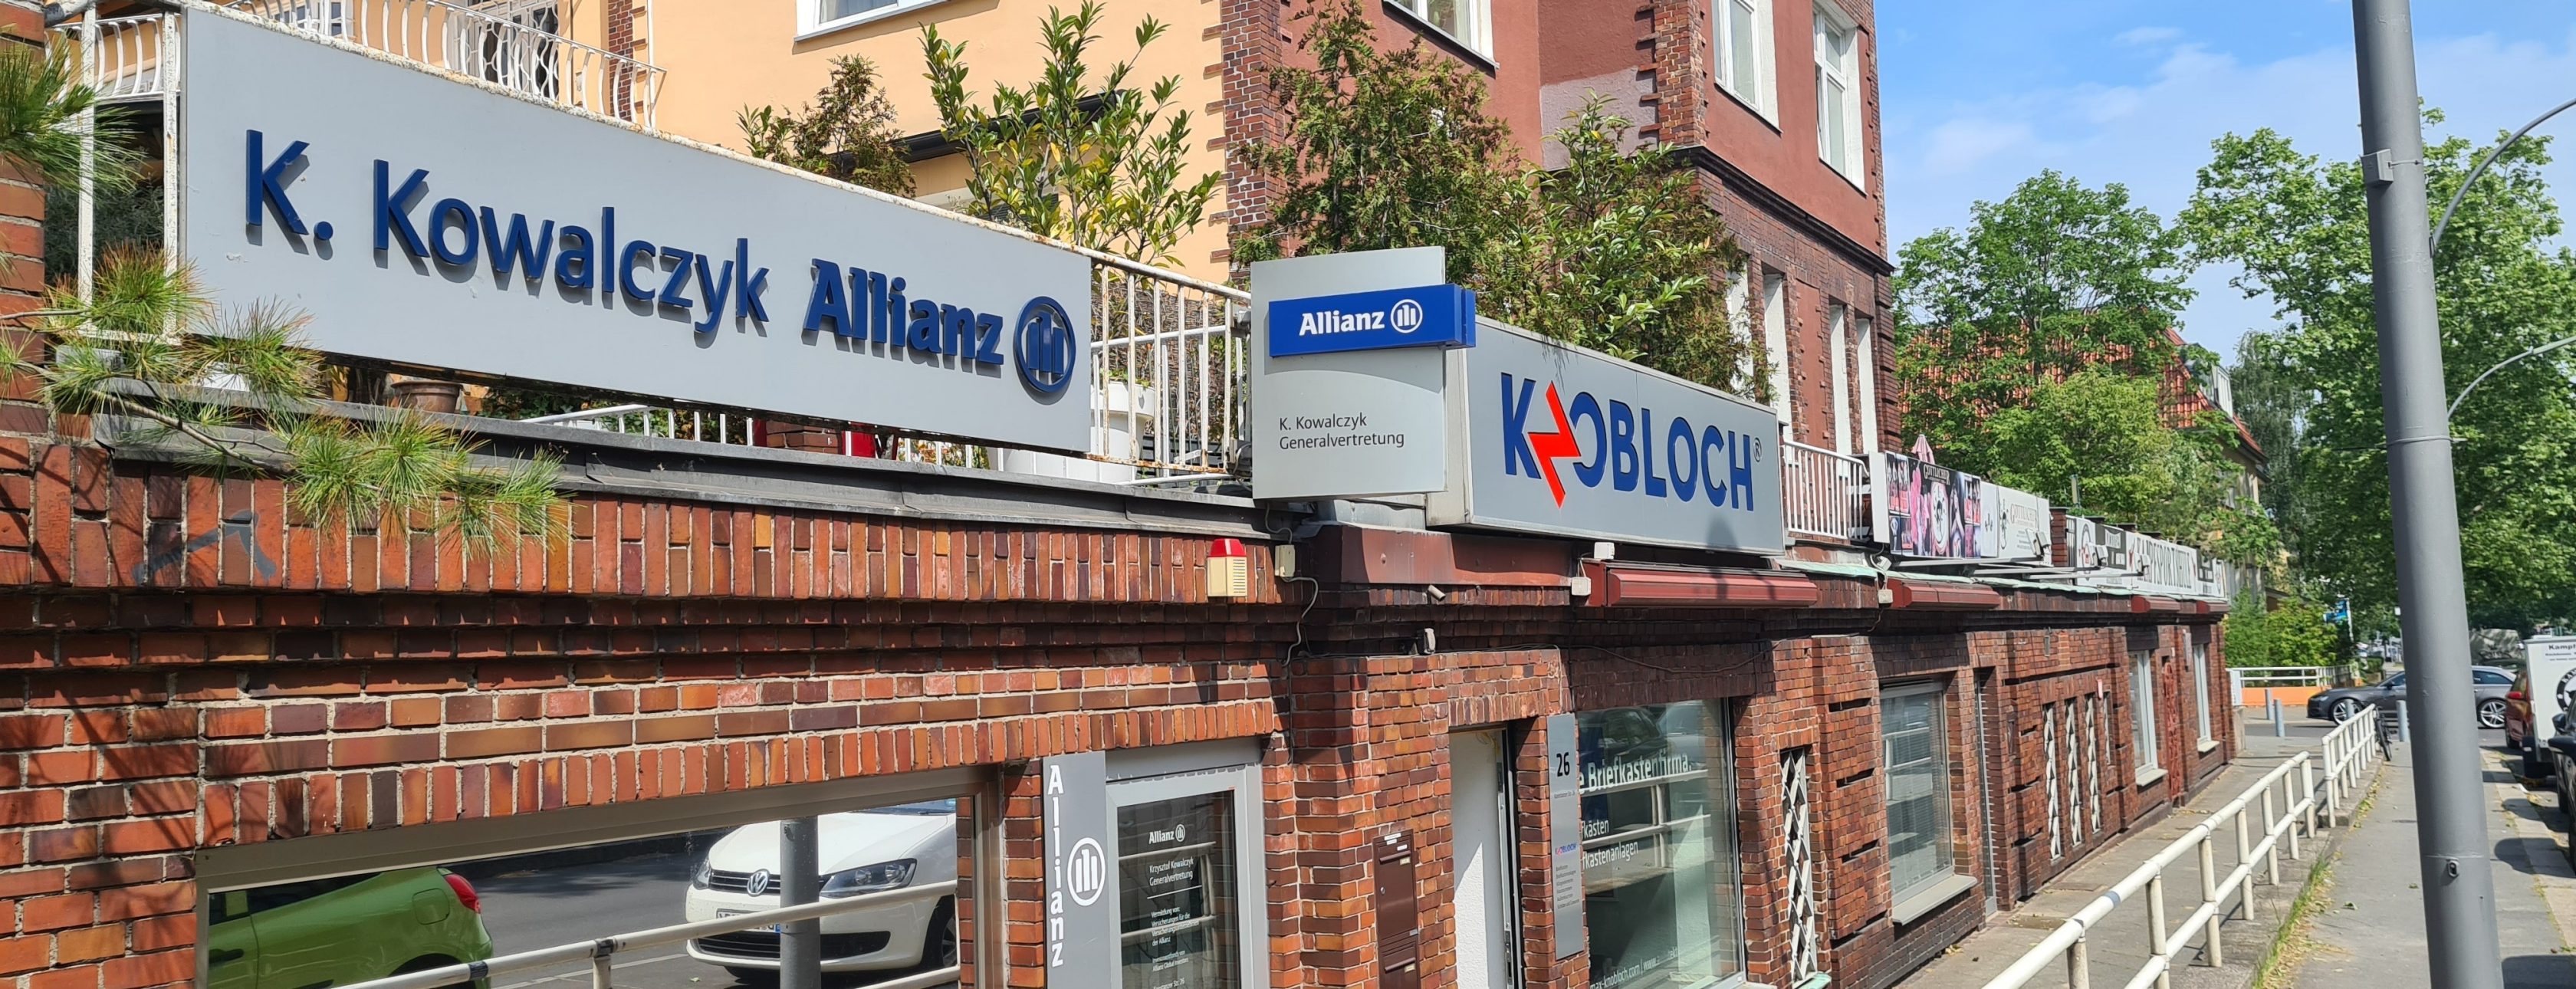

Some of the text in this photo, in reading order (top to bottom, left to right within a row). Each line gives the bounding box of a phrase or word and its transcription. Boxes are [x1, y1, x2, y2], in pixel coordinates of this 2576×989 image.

[245, 130, 1004, 365] K. Kowalczyk Allianz
[1299, 310, 1385, 336] Allianz
[1280, 412, 1367, 430] K. Kowalczyk
[1280, 432, 1405, 449] Generalvertretung
[1556, 752, 1570, 777] 26
[1149, 830, 1175, 844] Allianz
[1047, 764, 1064, 968] Allianz
[1149, 871, 1193, 886] Generalvertretung
